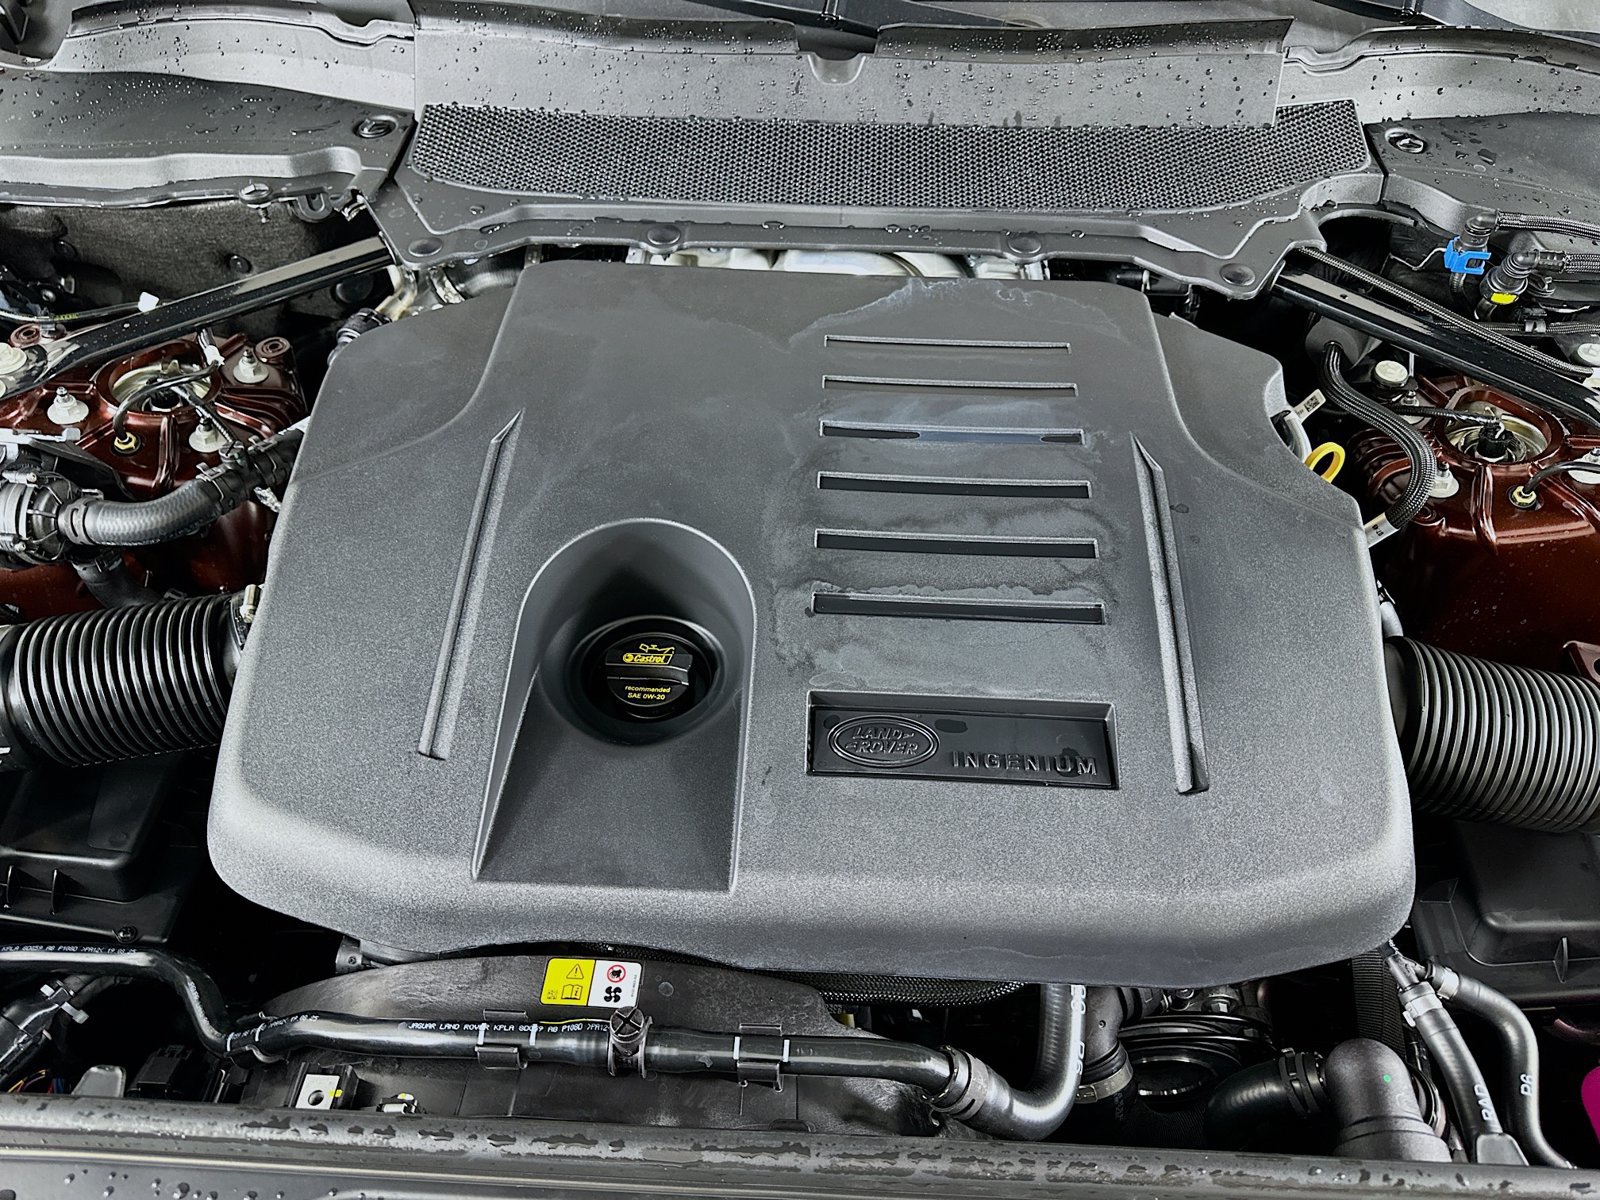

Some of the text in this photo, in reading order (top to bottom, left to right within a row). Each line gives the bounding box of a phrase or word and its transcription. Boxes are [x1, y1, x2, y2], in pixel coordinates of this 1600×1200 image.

[634, 653, 666, 663] Castrol
[851, 727, 904, 740] LAND
[855, 741, 919, 755] ROVER
[952, 751, 1097, 776] INGENIUM
[408, 1022, 437, 1030] JAGUAR
[1474, 1084, 1496, 1121] RAD
